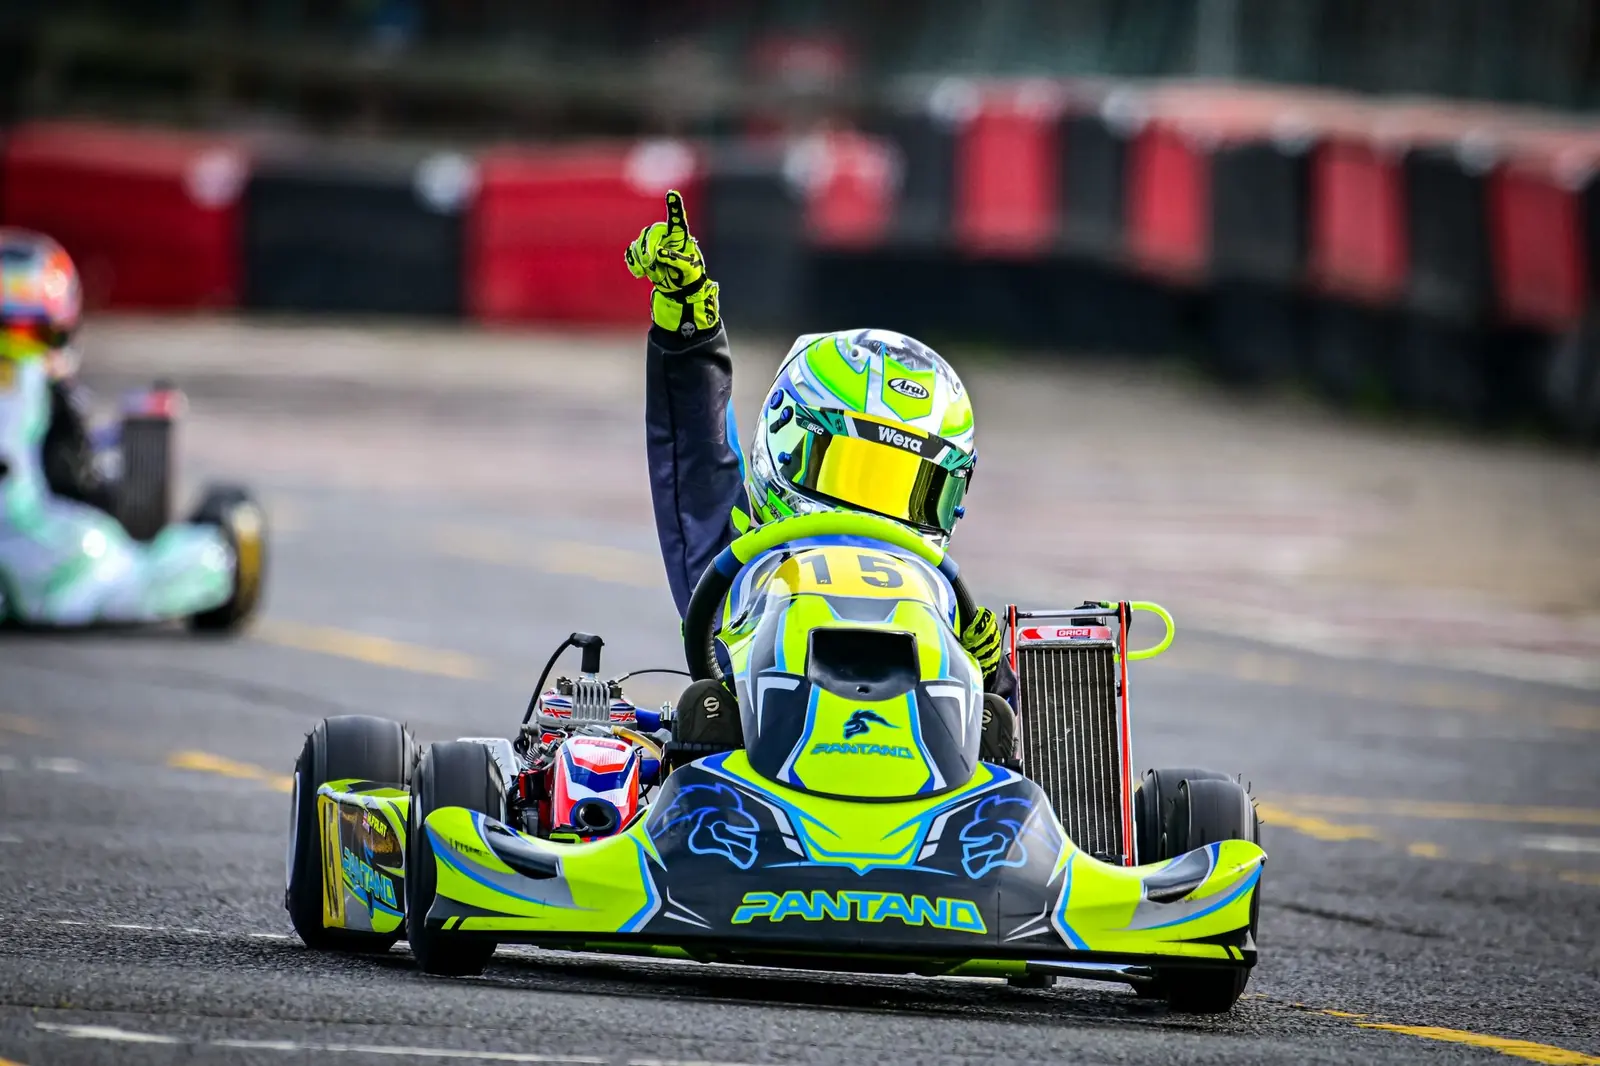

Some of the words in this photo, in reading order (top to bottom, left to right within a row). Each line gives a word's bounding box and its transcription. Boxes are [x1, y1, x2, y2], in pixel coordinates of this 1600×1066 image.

[892, 380, 925, 396] Arai
[878, 426, 923, 454] Wera
[1058, 628, 1089, 638] GRICE
